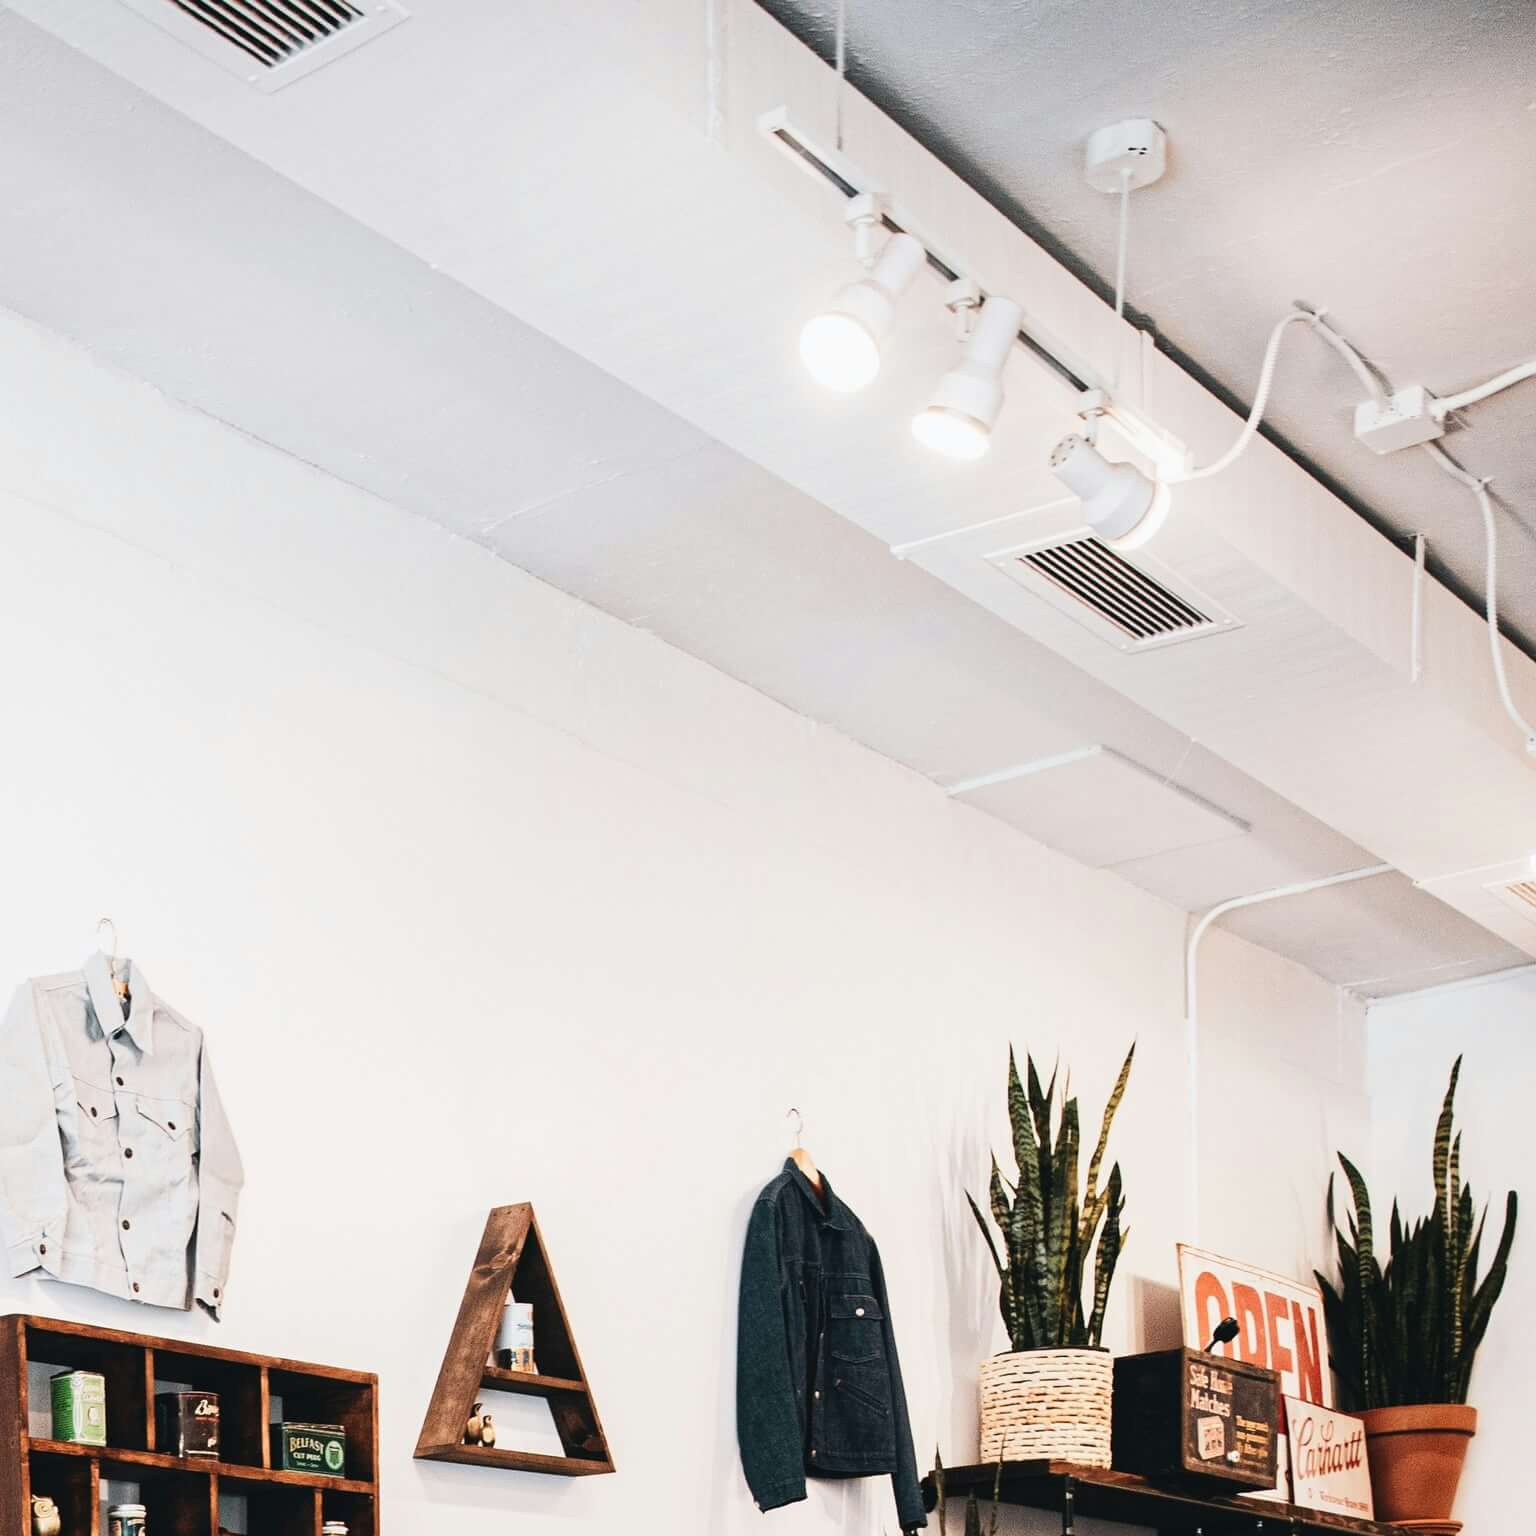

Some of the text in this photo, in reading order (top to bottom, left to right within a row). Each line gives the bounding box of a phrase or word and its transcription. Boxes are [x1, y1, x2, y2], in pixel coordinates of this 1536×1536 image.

[1195, 1271, 1323, 1407] OPEN
[1190, 1388, 1231, 1418] Matches
[289, 1436, 324, 1454] BELFAST
[1291, 1416, 1363, 1483] Carhartt
